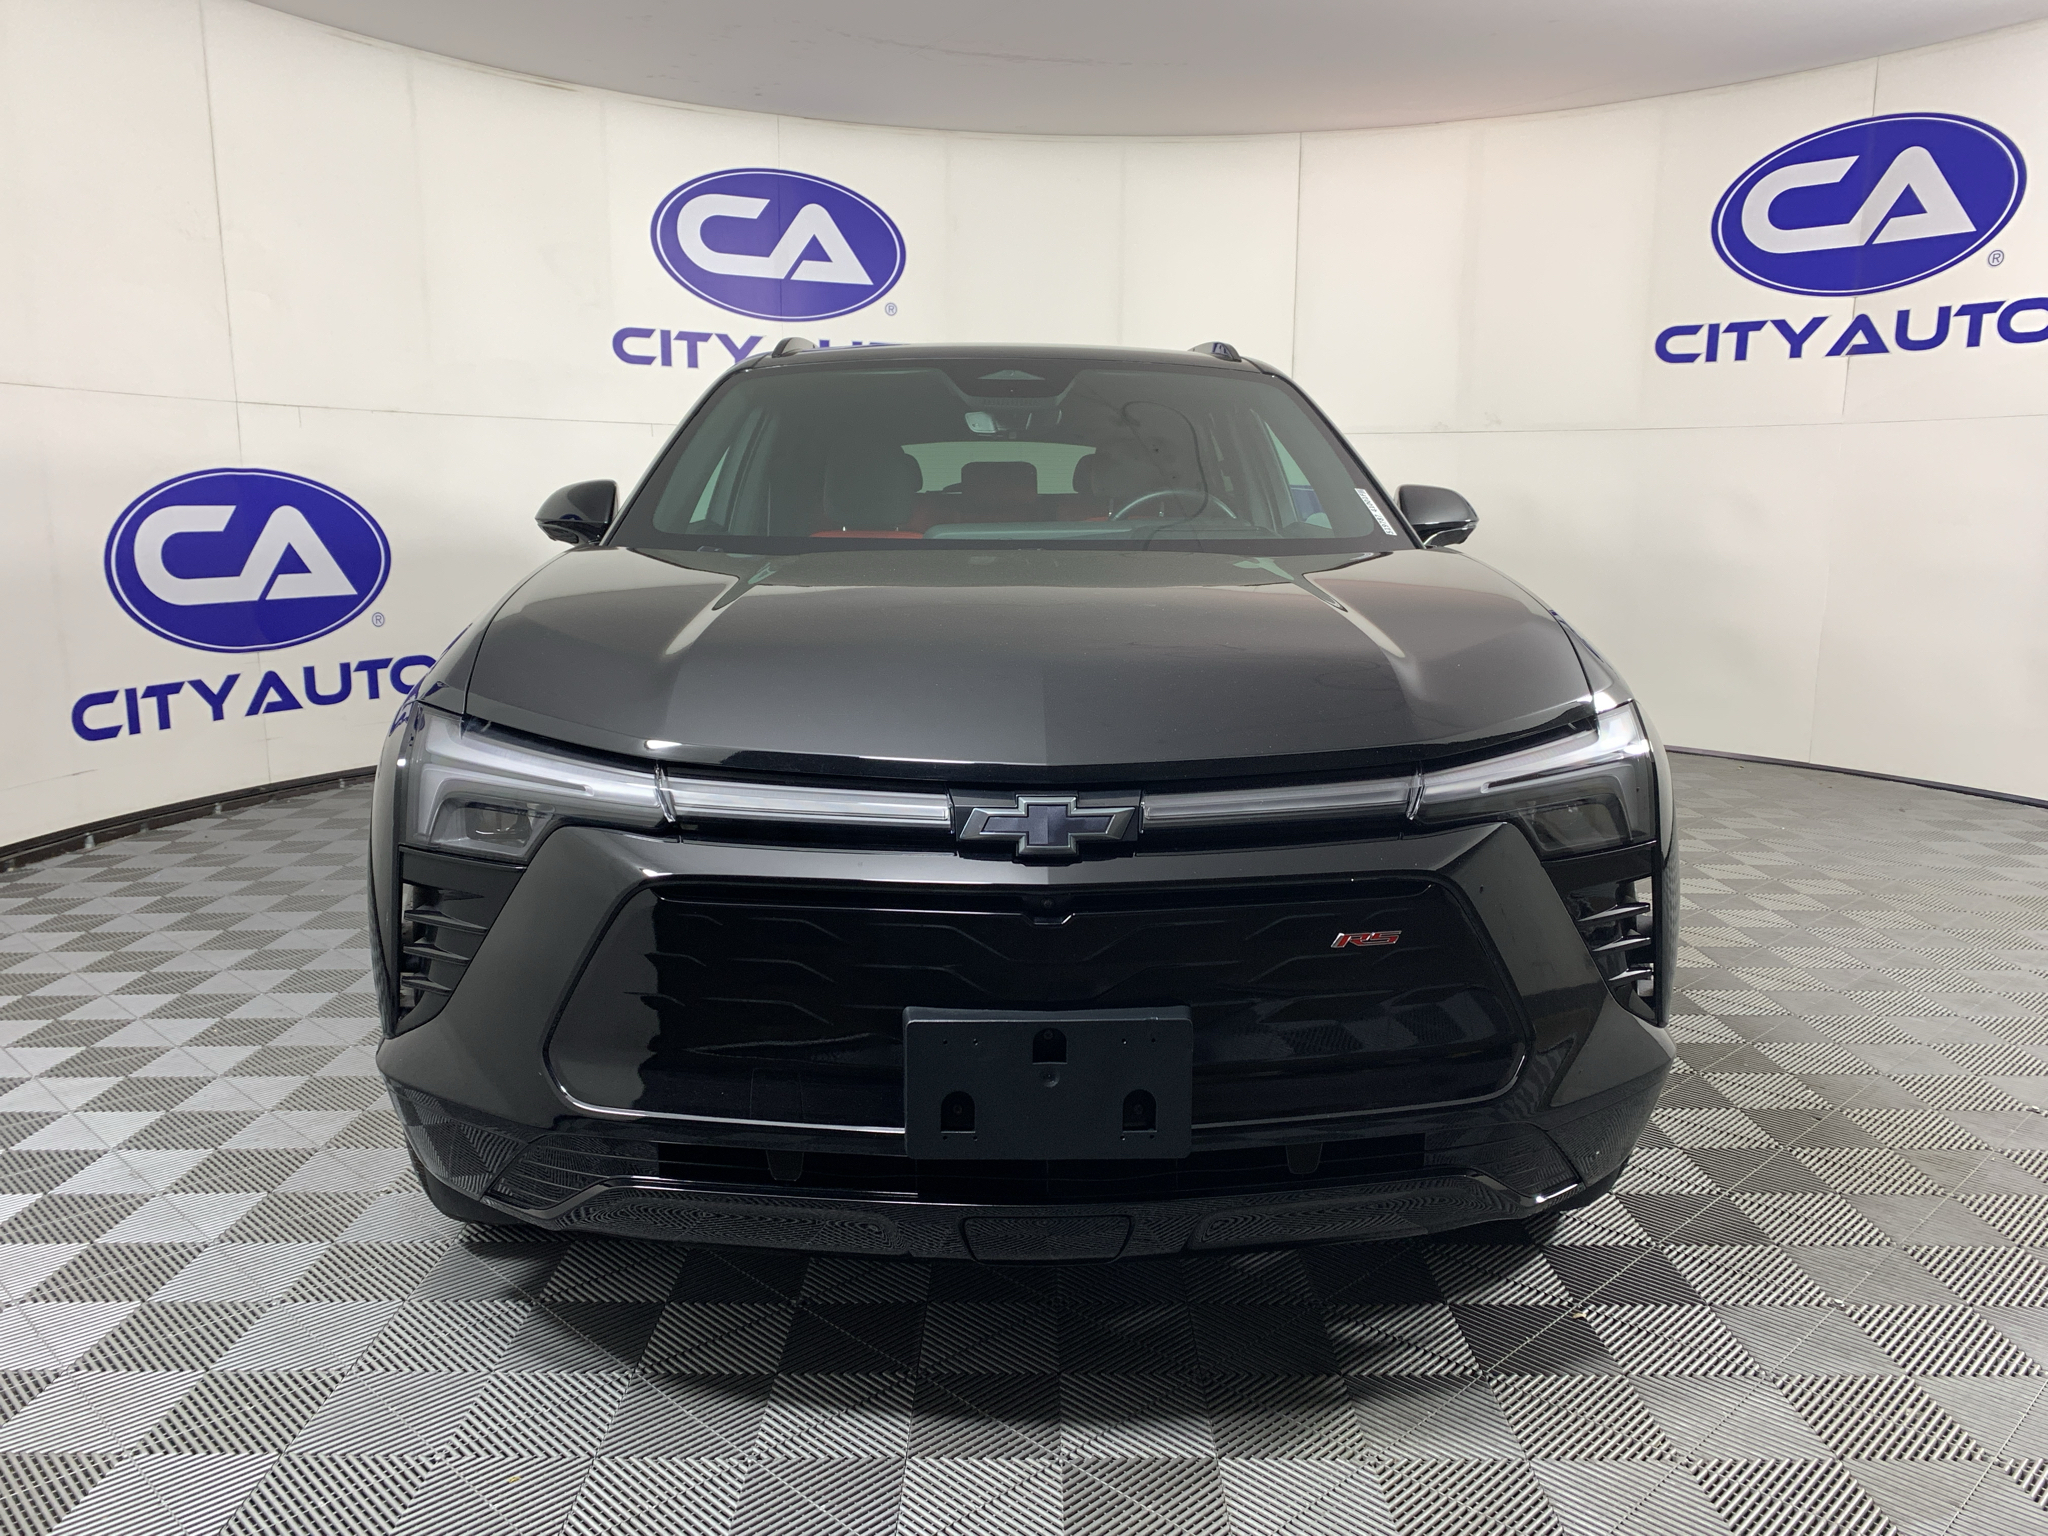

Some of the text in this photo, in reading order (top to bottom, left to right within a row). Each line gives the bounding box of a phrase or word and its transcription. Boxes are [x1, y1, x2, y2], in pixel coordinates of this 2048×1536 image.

[676, 193, 874, 286] CA
[1741, 145, 1977, 254] CA
[134, 505, 358, 606] CA
[1330, 929, 1403, 949] RS
